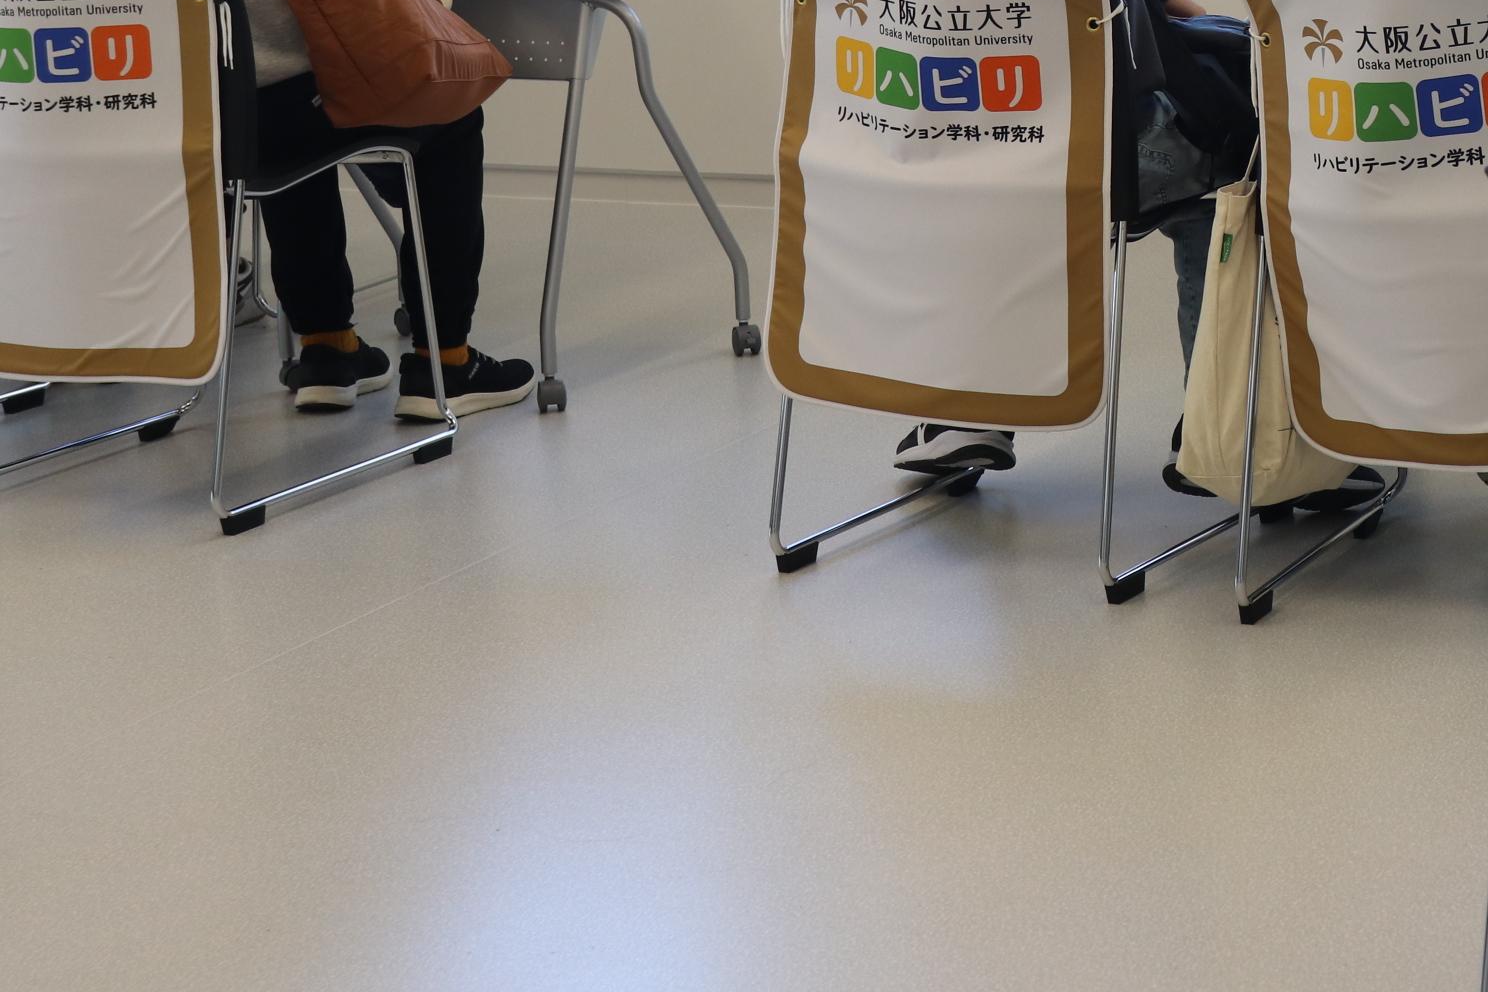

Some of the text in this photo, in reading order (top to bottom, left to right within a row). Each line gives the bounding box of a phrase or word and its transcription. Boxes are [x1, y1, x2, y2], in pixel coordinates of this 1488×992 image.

[17, 5, 83, 19] Metropolitan
[86, 3, 144, 17] University
[879, 24, 1034, 48] Osaka Metropolitan University
[1356, 57, 1391, 71] Osaka
[1395, 52, 1472, 71] Metropolitan
[843, 45, 1027, 109] リハビリ
[837, 105, 1045, 144] リハビリテーション学科・研究科
